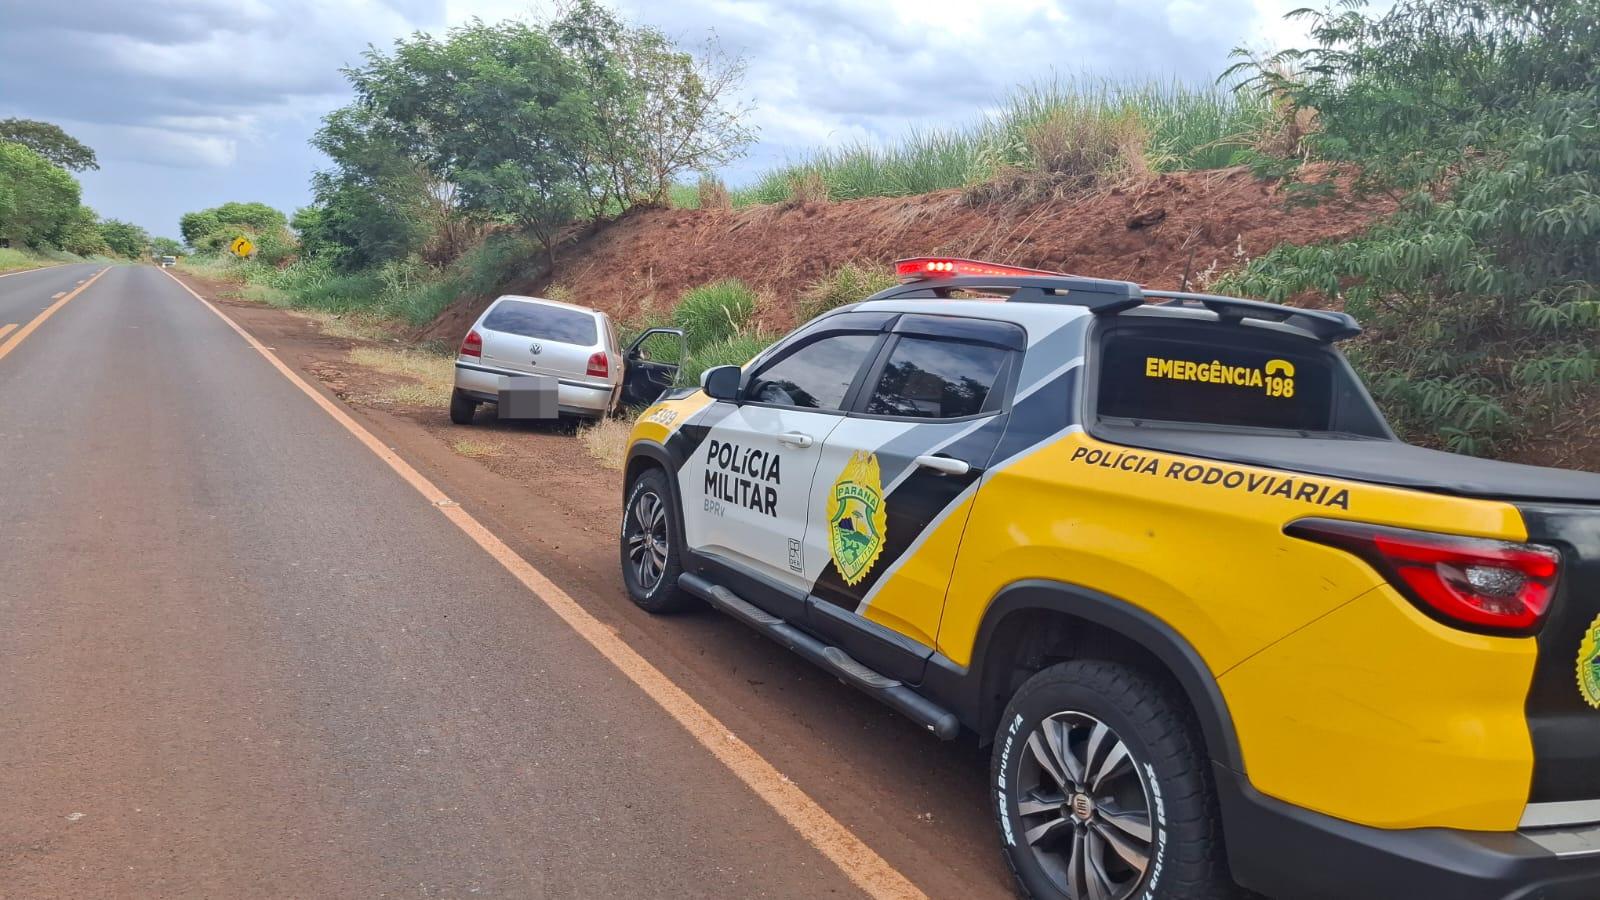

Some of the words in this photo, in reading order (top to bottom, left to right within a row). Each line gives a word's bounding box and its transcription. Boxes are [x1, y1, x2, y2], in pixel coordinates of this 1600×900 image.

[1145, 357, 1263, 388] EMERGÊNCIA
[1265, 376, 1294, 398] 198
[707, 439, 780, 485] POLÍCIA
[1070, 446, 1158, 476] POLÍCIA
[1164, 461, 1350, 511] RODOVIÁRIA
[704, 468, 778, 518] MILITAR
[998, 736, 1013, 790] Brutus
[1008, 713, 1024, 735] T/A
[1149, 828, 1167, 891] Brutus
